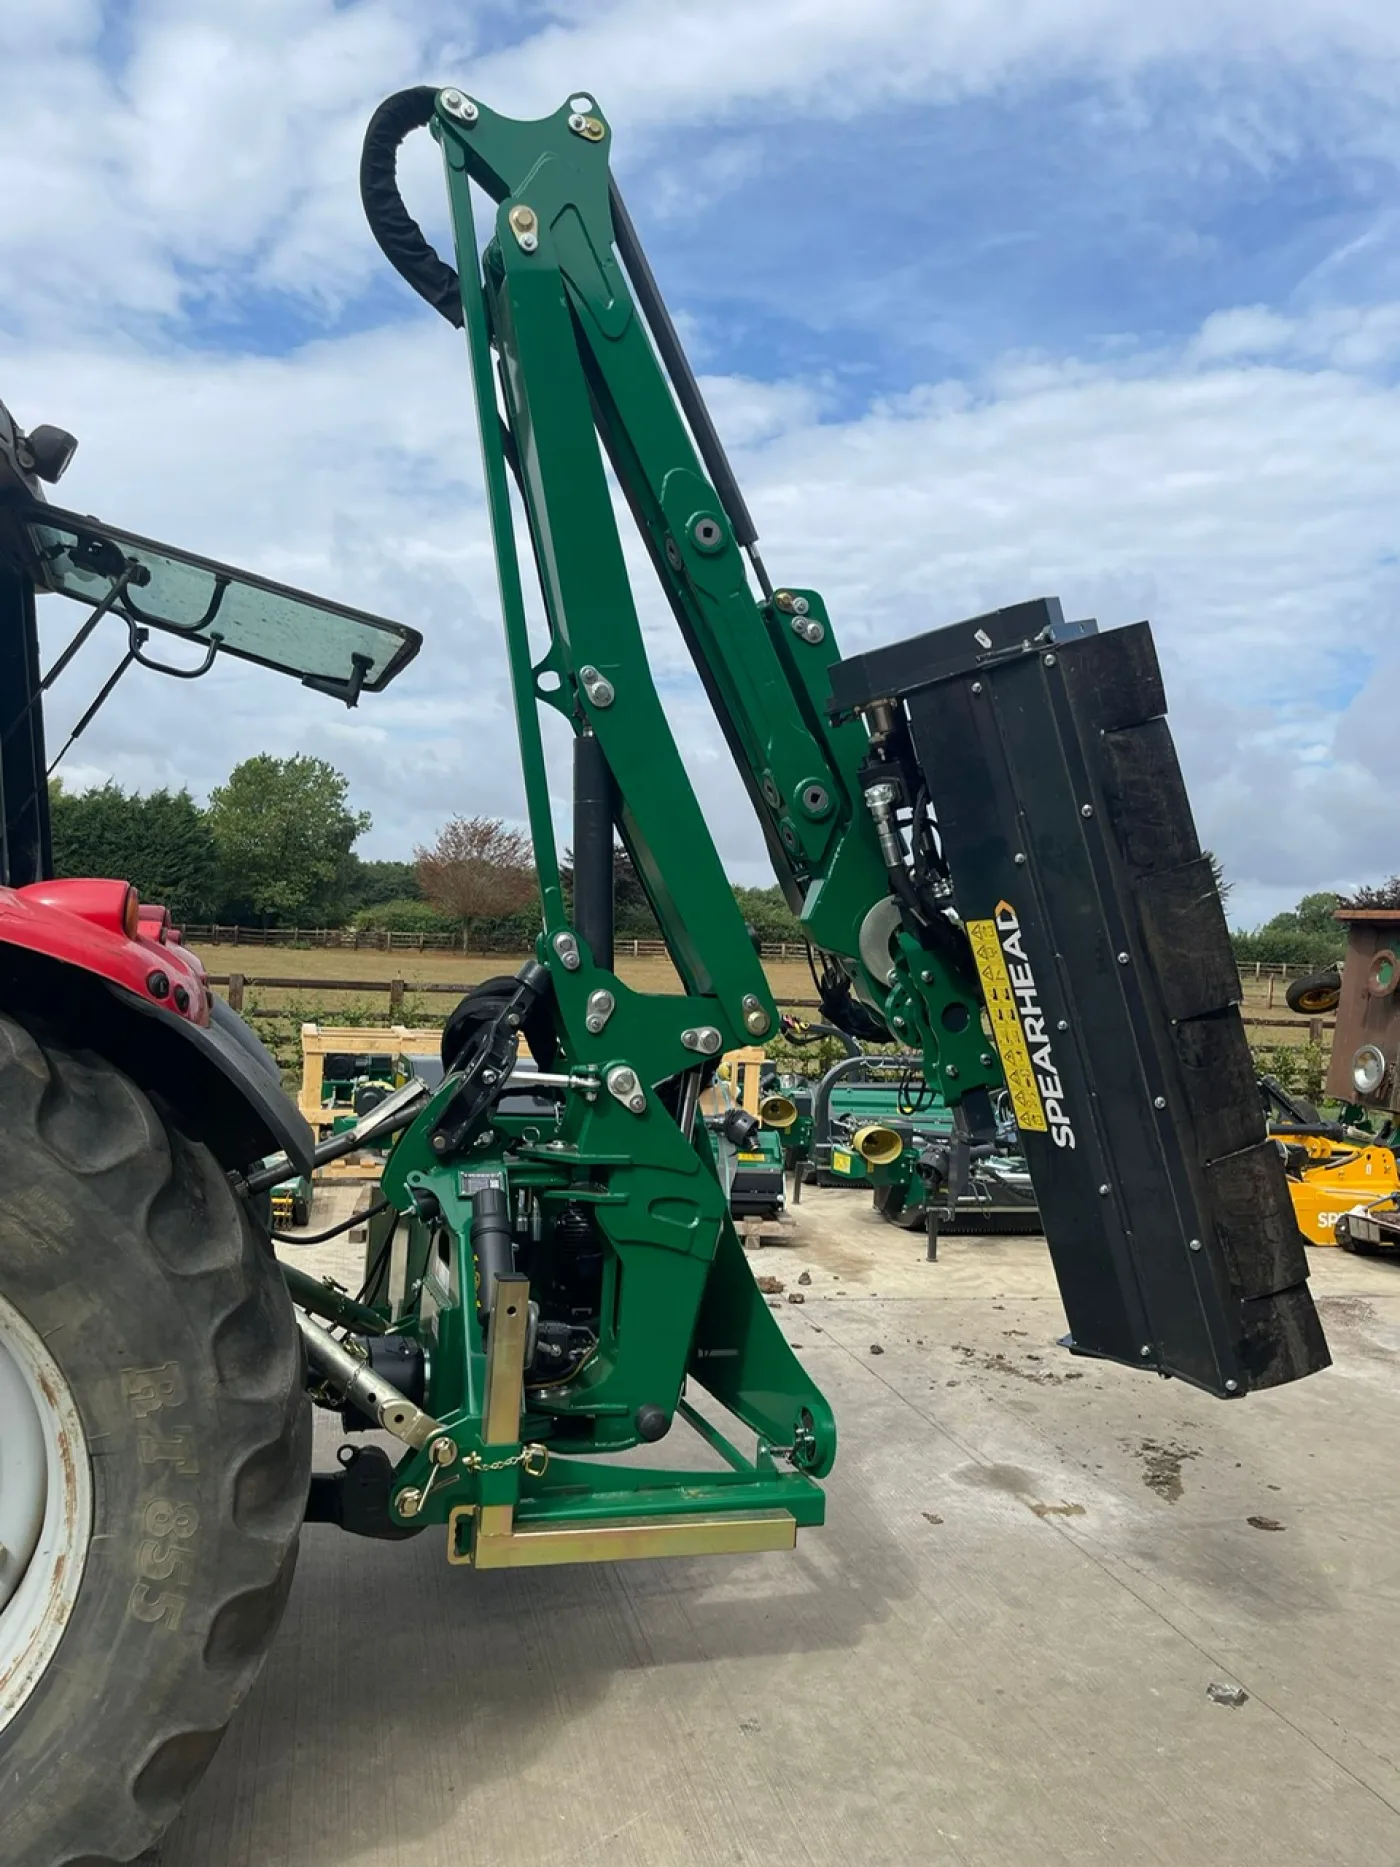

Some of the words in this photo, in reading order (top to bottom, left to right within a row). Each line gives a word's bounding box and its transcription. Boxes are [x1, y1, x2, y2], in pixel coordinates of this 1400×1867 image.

[995, 900, 1075, 1149] SPEARHEAD
[1317, 1211, 1347, 1228] SP
[129, 1498, 200, 1630] 855
